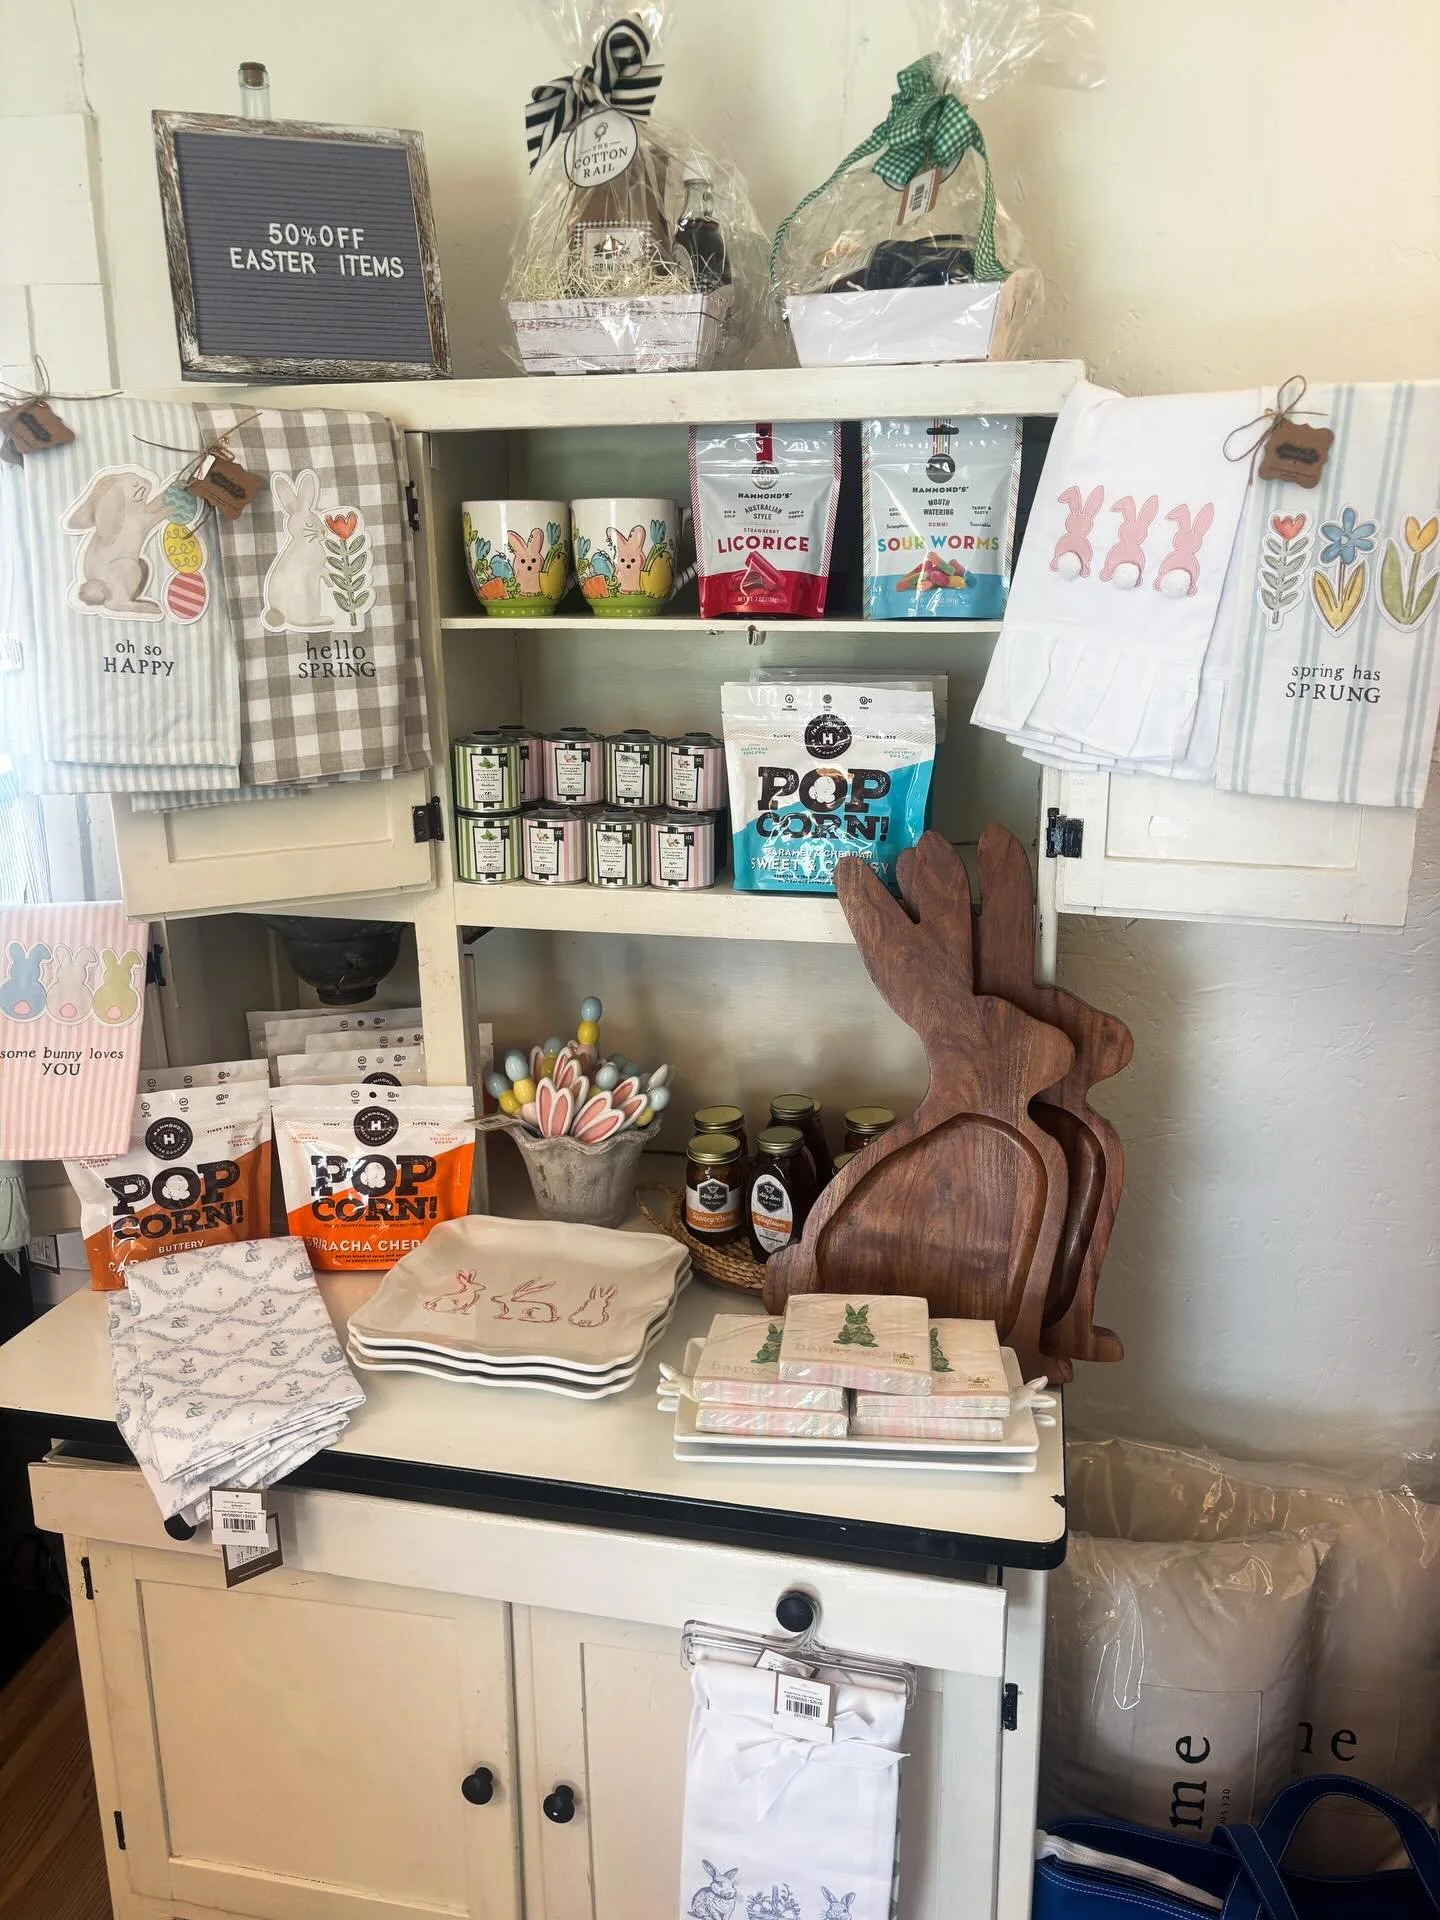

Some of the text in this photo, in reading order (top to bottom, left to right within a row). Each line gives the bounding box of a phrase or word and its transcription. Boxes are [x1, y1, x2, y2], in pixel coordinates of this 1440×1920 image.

[574, 146, 628, 170] COTTON
[583, 163, 615, 179] RAIL
[229, 247, 405, 278] EASTER ITEMS
[744, 503, 783, 514] AUSTRALIAN
[928, 498, 950, 506] MOUTH
[753, 512, 772, 520] STYLE
[923, 508, 954, 516] WATERING
[717, 535, 809, 553] LICORICE
[877, 535, 1000, 553] SOUR WORMS
[115, 638, 162, 656] oh so
[305, 639, 366, 660] hello
[103, 656, 175, 677] HAPPY
[298, 661, 377, 679] SPRING
[1292, 663, 1381, 681] spring has
[1285, 682, 1381, 704] SPRUNG
[757, 766, 891, 813] POP
[756, 811, 890, 842] CORN!
[751, 857, 799, 872] SWEET
[0, 1046, 124, 1061] some bunny loves
[41, 1062, 80, 1076] YOU
[310, 1154, 438, 1198] POP
[104, 1159, 241, 1216] POP
[311, 1196, 438, 1222] CORN!
[112, 1200, 245, 1240] CORN!
[158, 1240, 205, 1254] BUTTERY
[305, 1236, 421, 1252] SRIRACHA CHED
[1169, 1734, 1212, 1830] me
